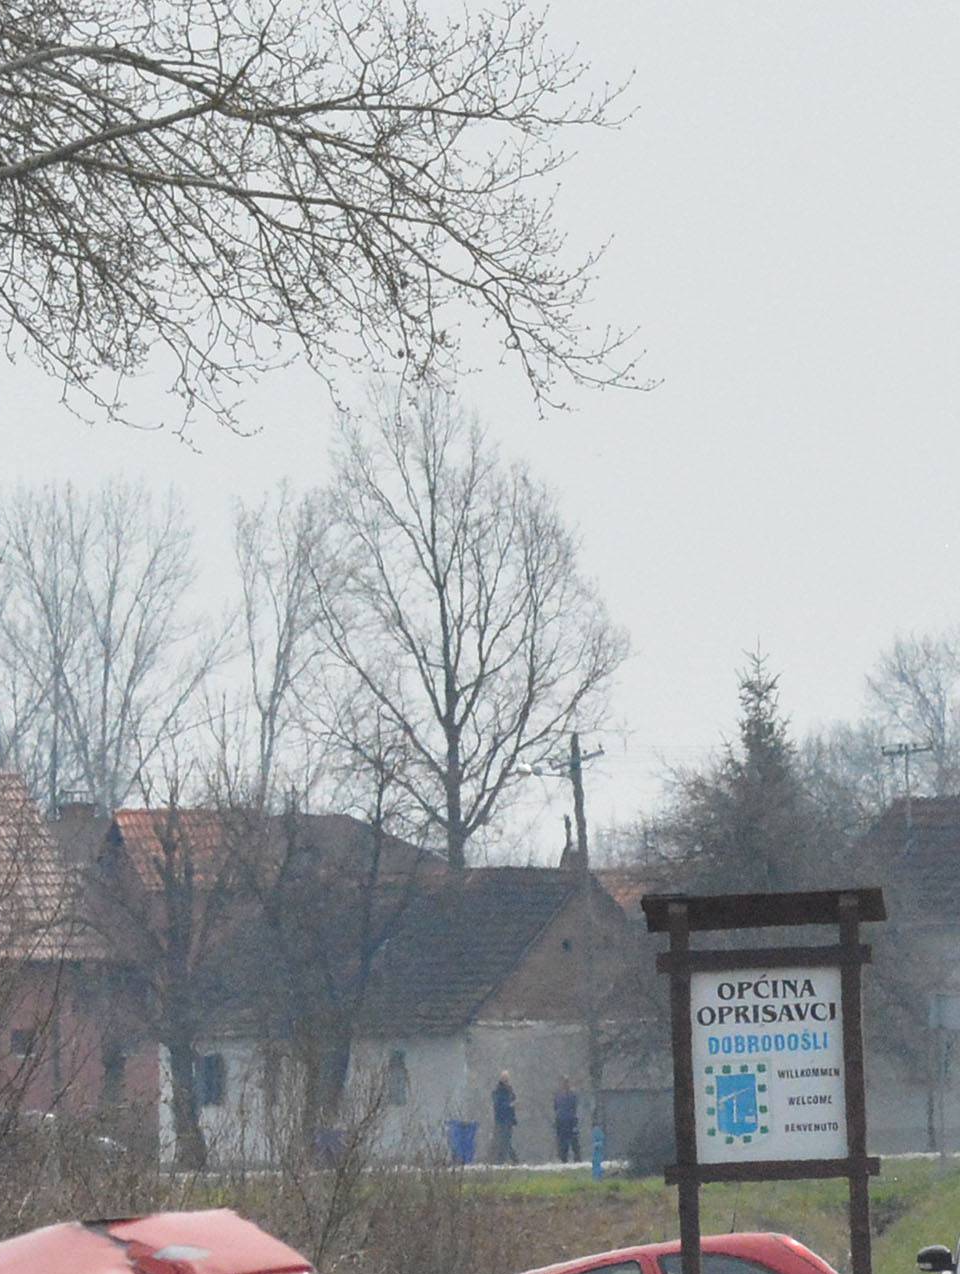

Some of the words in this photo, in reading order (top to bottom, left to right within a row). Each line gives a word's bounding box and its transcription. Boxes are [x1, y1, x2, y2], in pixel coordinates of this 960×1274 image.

[717, 974, 816, 1001] OPĆINA
[696, 1002, 837, 1026] OPRISAVCI
[707, 1029, 829, 1055] DOBRODOŠLI
[777, 1067, 840, 1079] WILLKOMMEN
[787, 1095, 832, 1106] WELCOME
[784, 1122, 838, 1133] BENVENUTO
